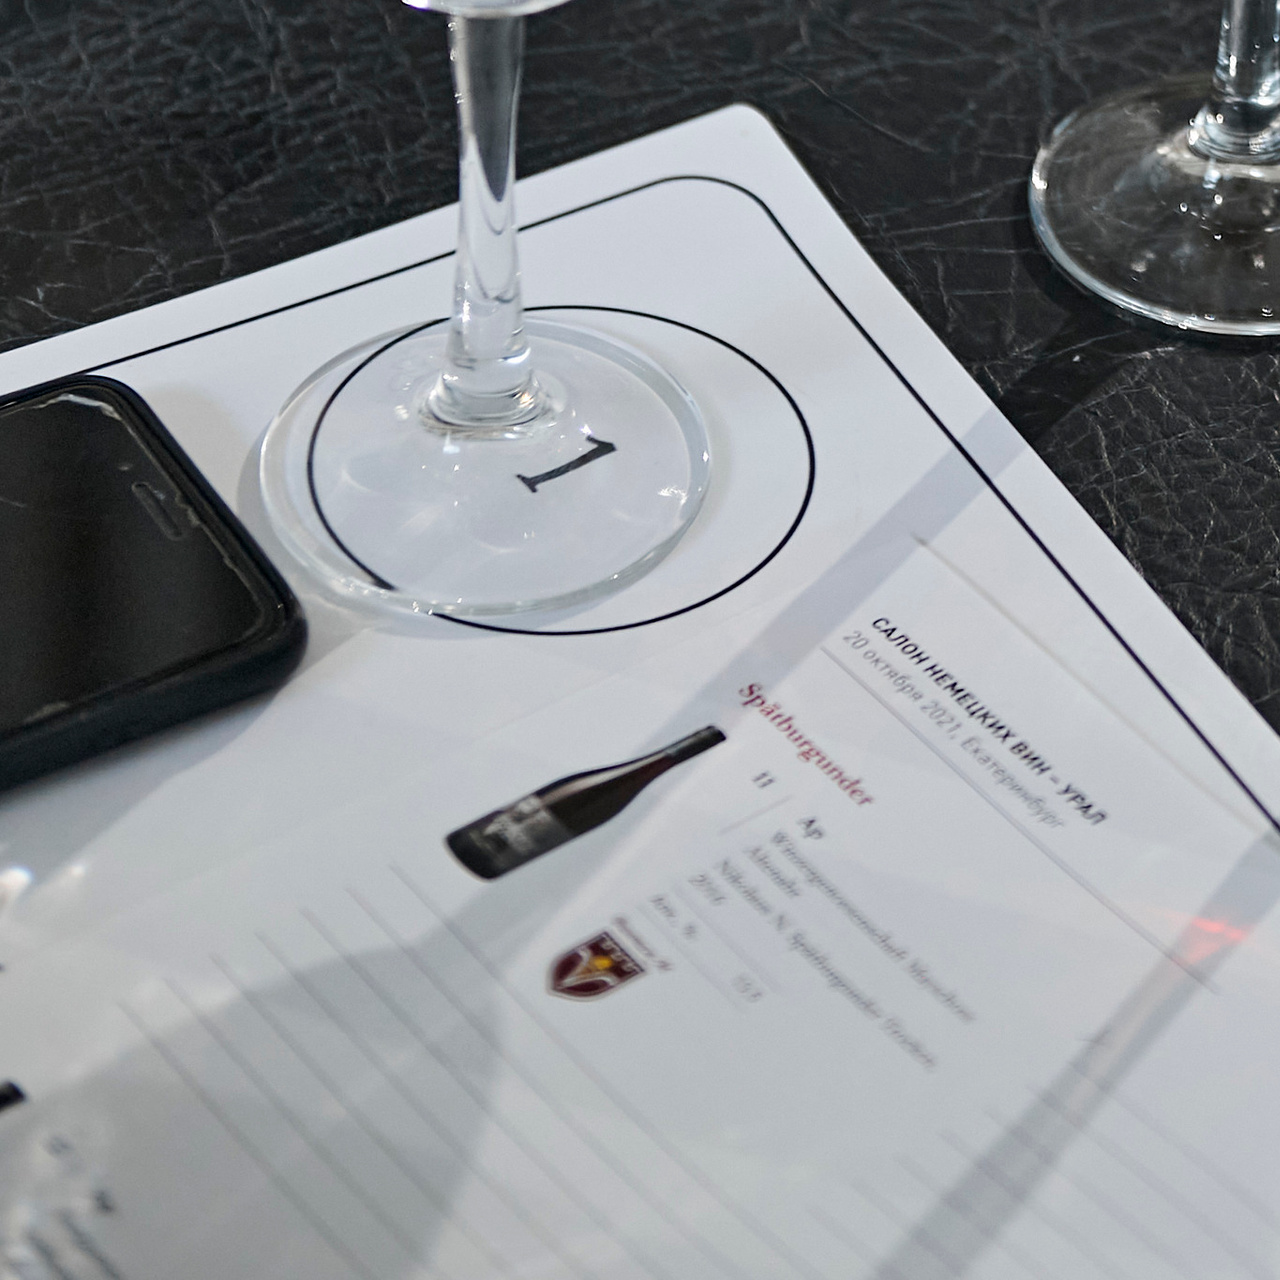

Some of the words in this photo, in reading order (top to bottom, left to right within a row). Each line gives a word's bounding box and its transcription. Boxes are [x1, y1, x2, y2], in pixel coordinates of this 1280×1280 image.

[516, 434, 617, 493] 1
[736, 681, 875, 807] Spätburgunder
[842, 630, 872, 650] 20
[862, 648, 925, 703] октября
[959, 735, 1066, 829] Екатеринбург
[871, 617, 930, 665] САЛОН
[923, 663, 1017, 744] НЕМЕЦКИХ
[1009, 741, 1052, 775] ВИН
[1057, 783, 1108, 826] УРАЛ
